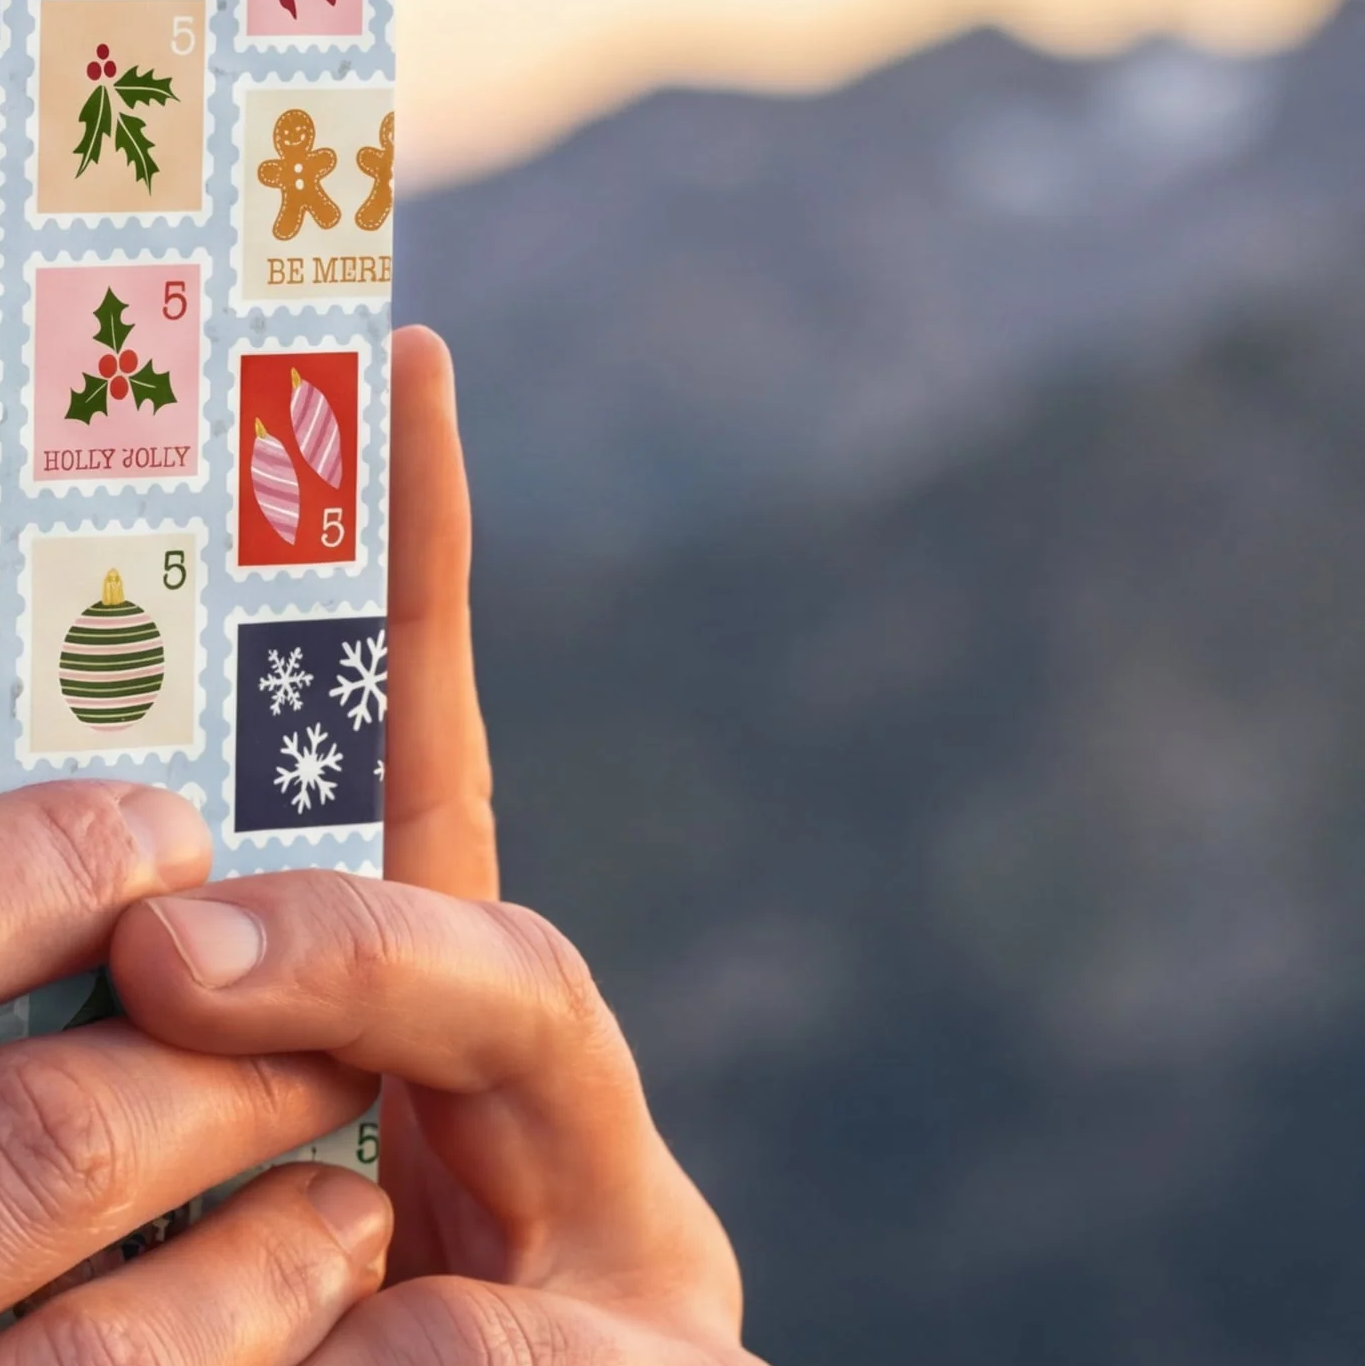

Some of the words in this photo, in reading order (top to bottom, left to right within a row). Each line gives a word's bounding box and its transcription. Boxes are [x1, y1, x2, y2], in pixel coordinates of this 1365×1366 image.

[170, 15, 196, 56] 5
[266, 257, 305, 285] BE
[162, 280, 188, 321] 5
[43, 448, 116, 472] HOLLY
[121, 445, 191, 469] JOLLY
[320, 507, 345, 548] 5
[163, 549, 187, 591] 5
[356, 1122, 379, 1165] 5
